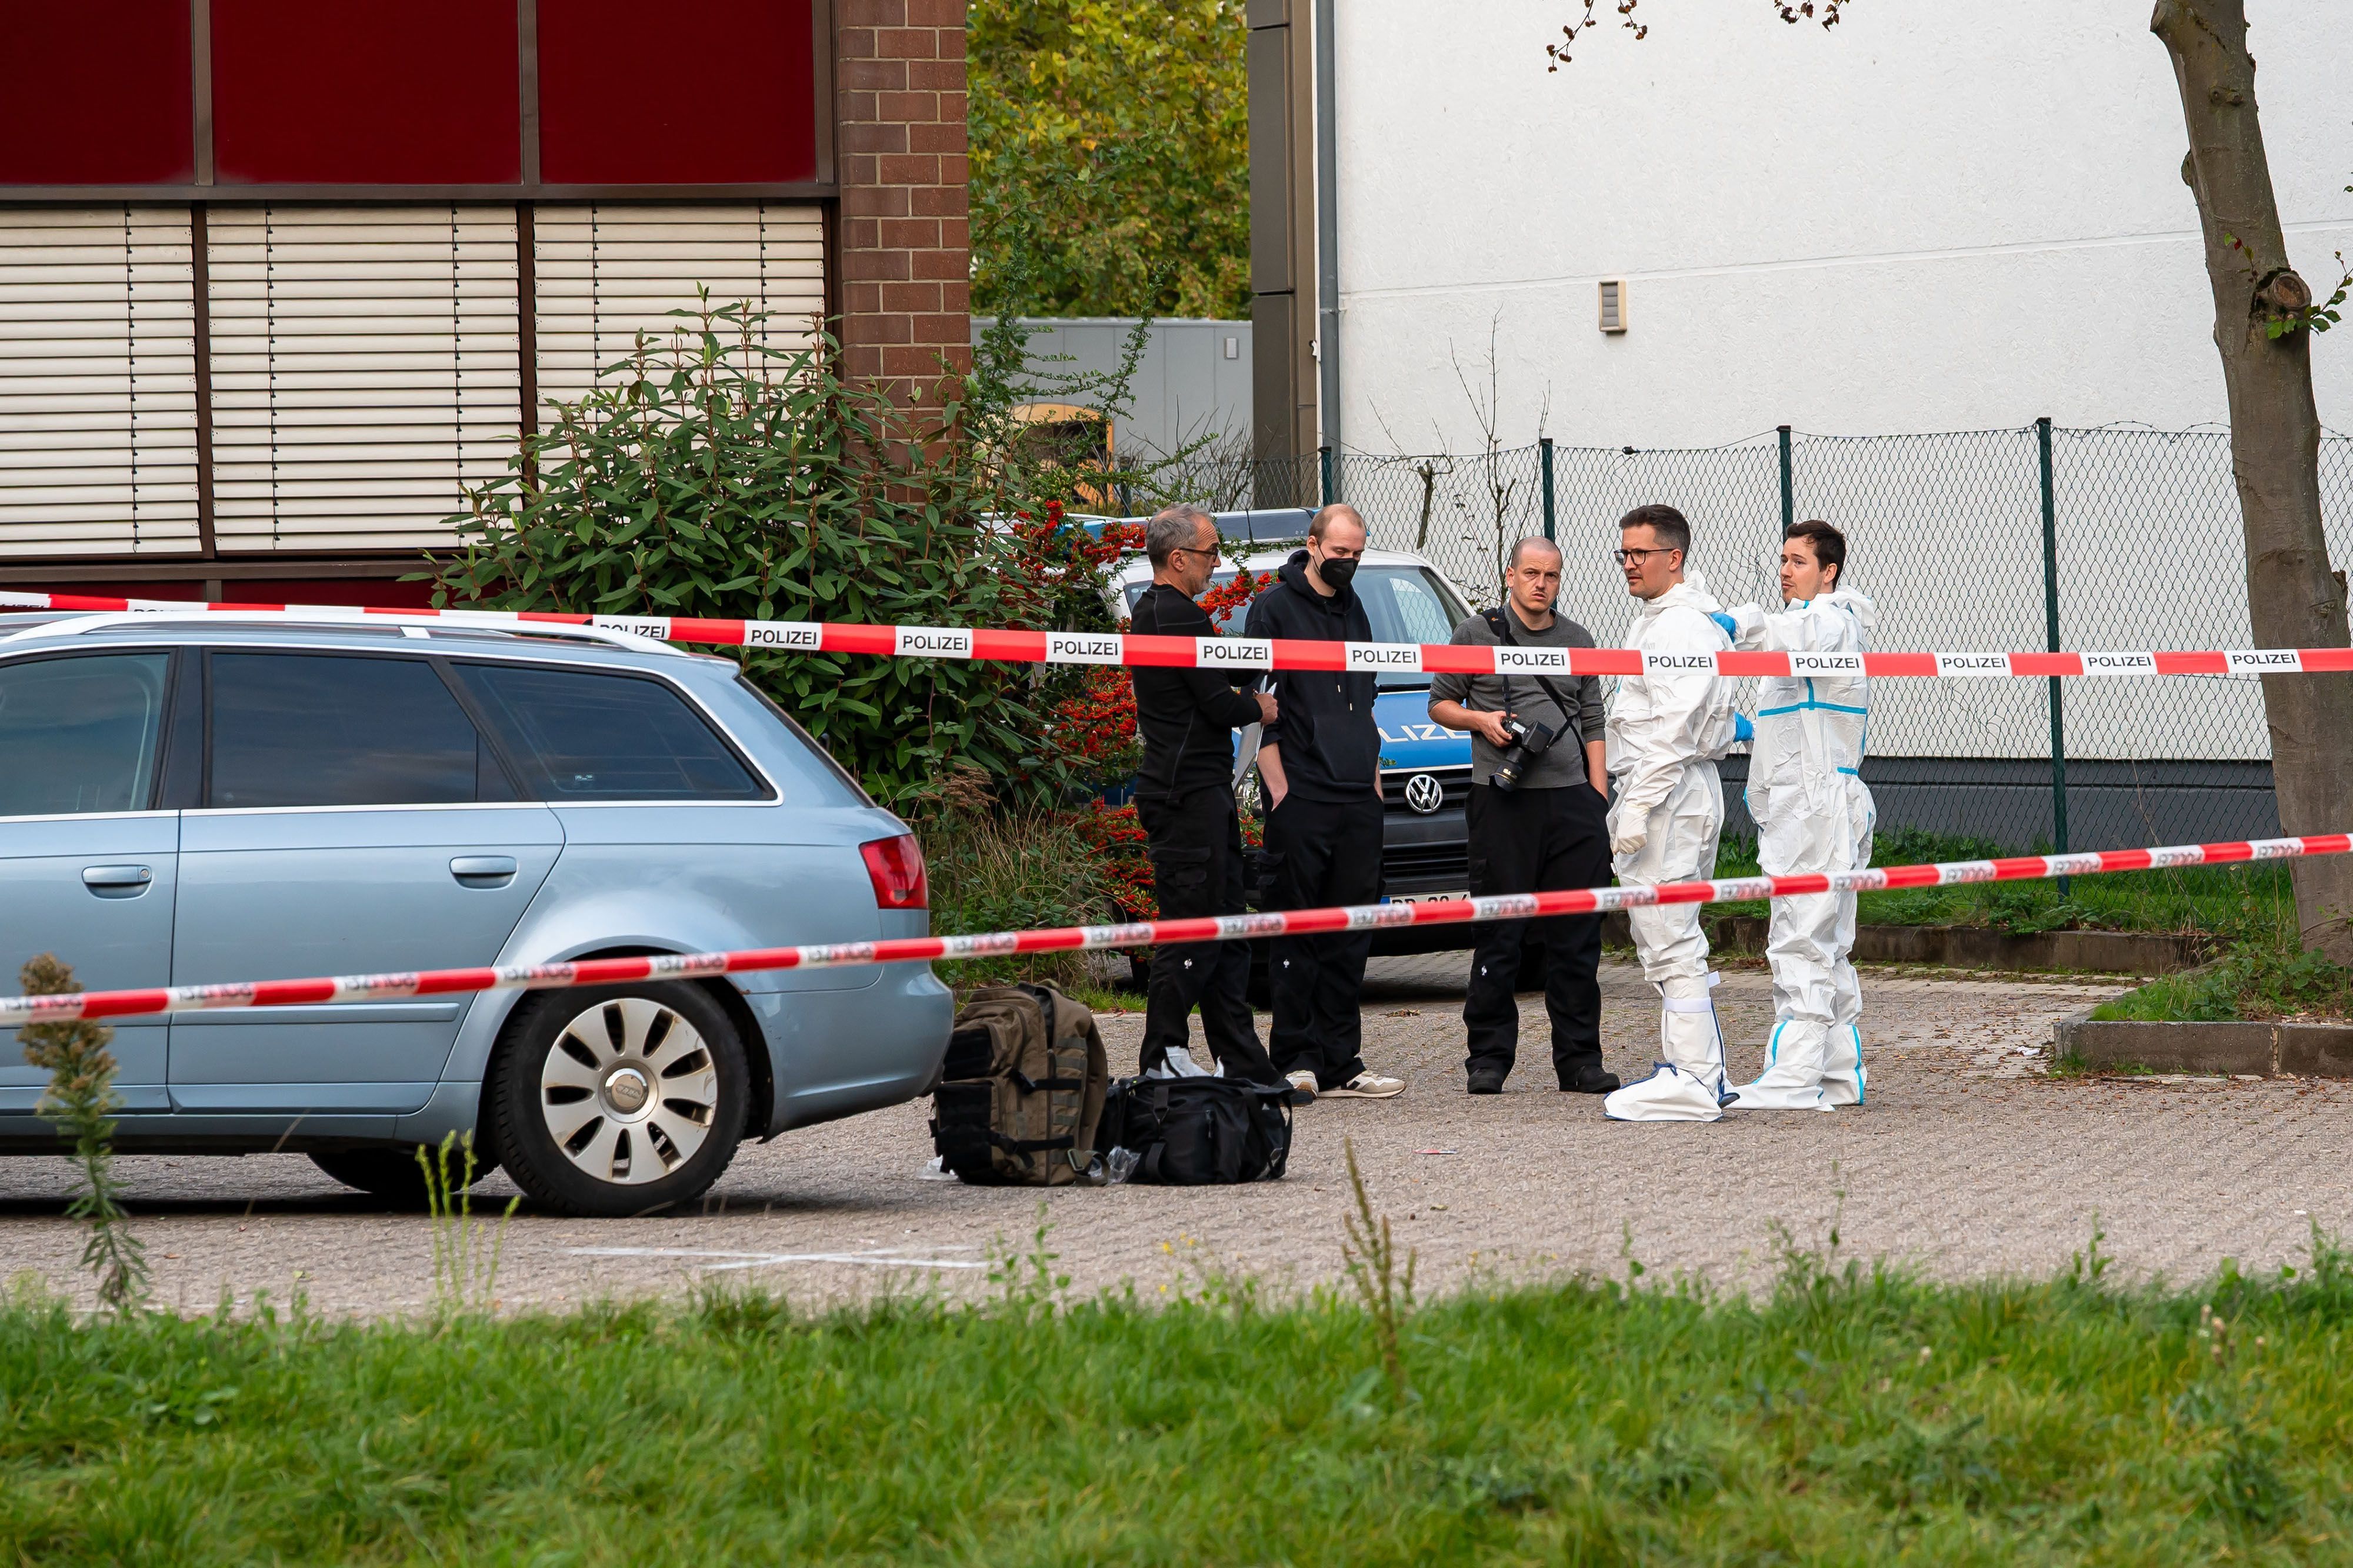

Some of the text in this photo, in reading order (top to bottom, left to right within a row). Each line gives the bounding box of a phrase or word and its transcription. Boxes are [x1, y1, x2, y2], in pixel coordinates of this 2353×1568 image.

[751, 630, 816, 645] POLIZEI
[904, 636, 968, 650] POLIZEI
[1054, 641, 1118, 656] POLIZEI
[1204, 646, 1268, 660] POLIZEI
[1353, 650, 1417, 663] POLIZEI
[1501, 654, 1565, 666] POLIZEI
[1649, 656, 1712, 668] POLIZEI
[1796, 658, 1859, 669] POLIZEI
[1943, 658, 2006, 668] POLIZEI
[2088, 656, 2151, 667] POLIZEI
[2232, 654, 2296, 665] POLIZEI
